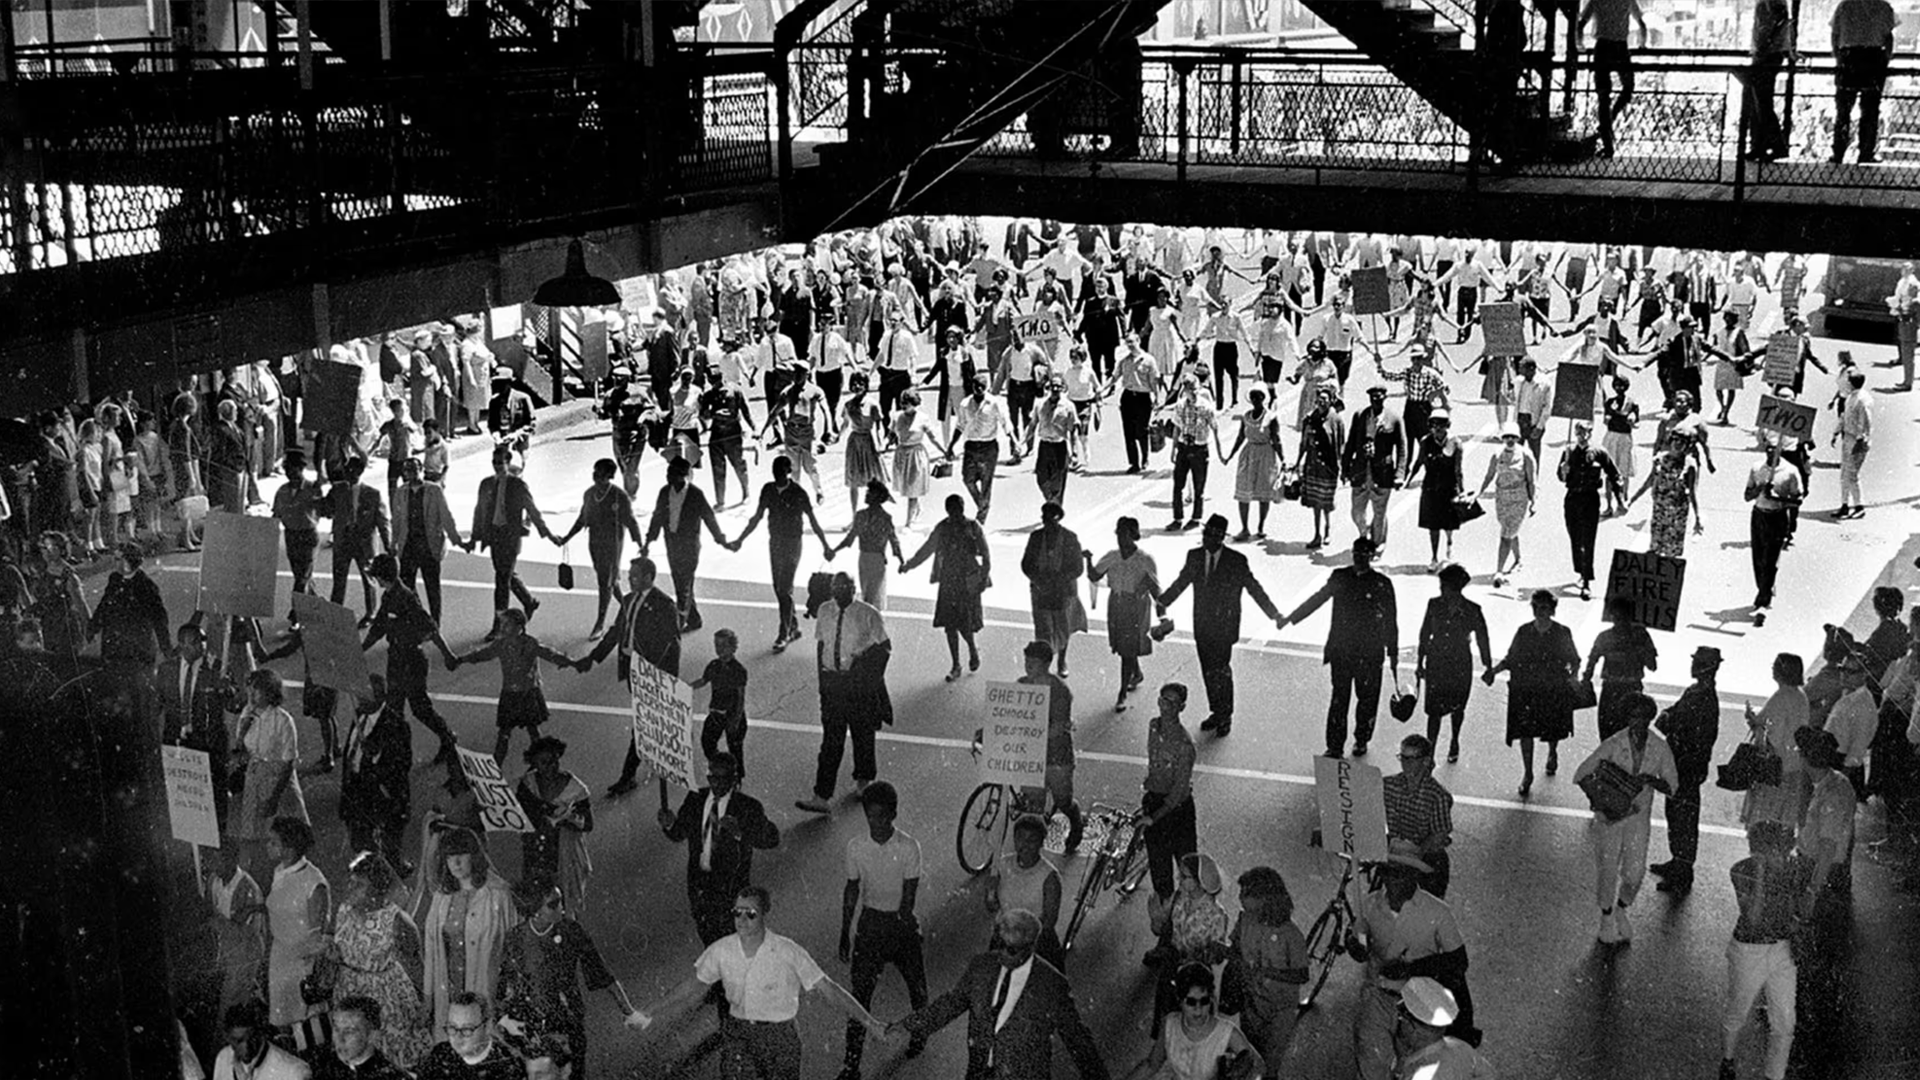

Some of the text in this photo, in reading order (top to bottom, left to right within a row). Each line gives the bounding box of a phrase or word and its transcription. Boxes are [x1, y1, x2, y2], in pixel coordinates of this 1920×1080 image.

[1613, 552, 1683, 580] DALEY
[1614, 576, 1671, 602] FIRE
[1618, 600, 1677, 628] ILLIS
[638, 655, 679, 697] DALEY
[988, 688, 1045, 706] GHETTO
[992, 707, 1036, 720] SCHOOLS
[995, 725, 1045, 739] DESTROY
[1003, 743, 1027, 754] OUR
[987, 759, 1043, 774] CHILDREN
[484, 806, 524, 830] GO
[1338, 761, 1354, 854] RESIGN
